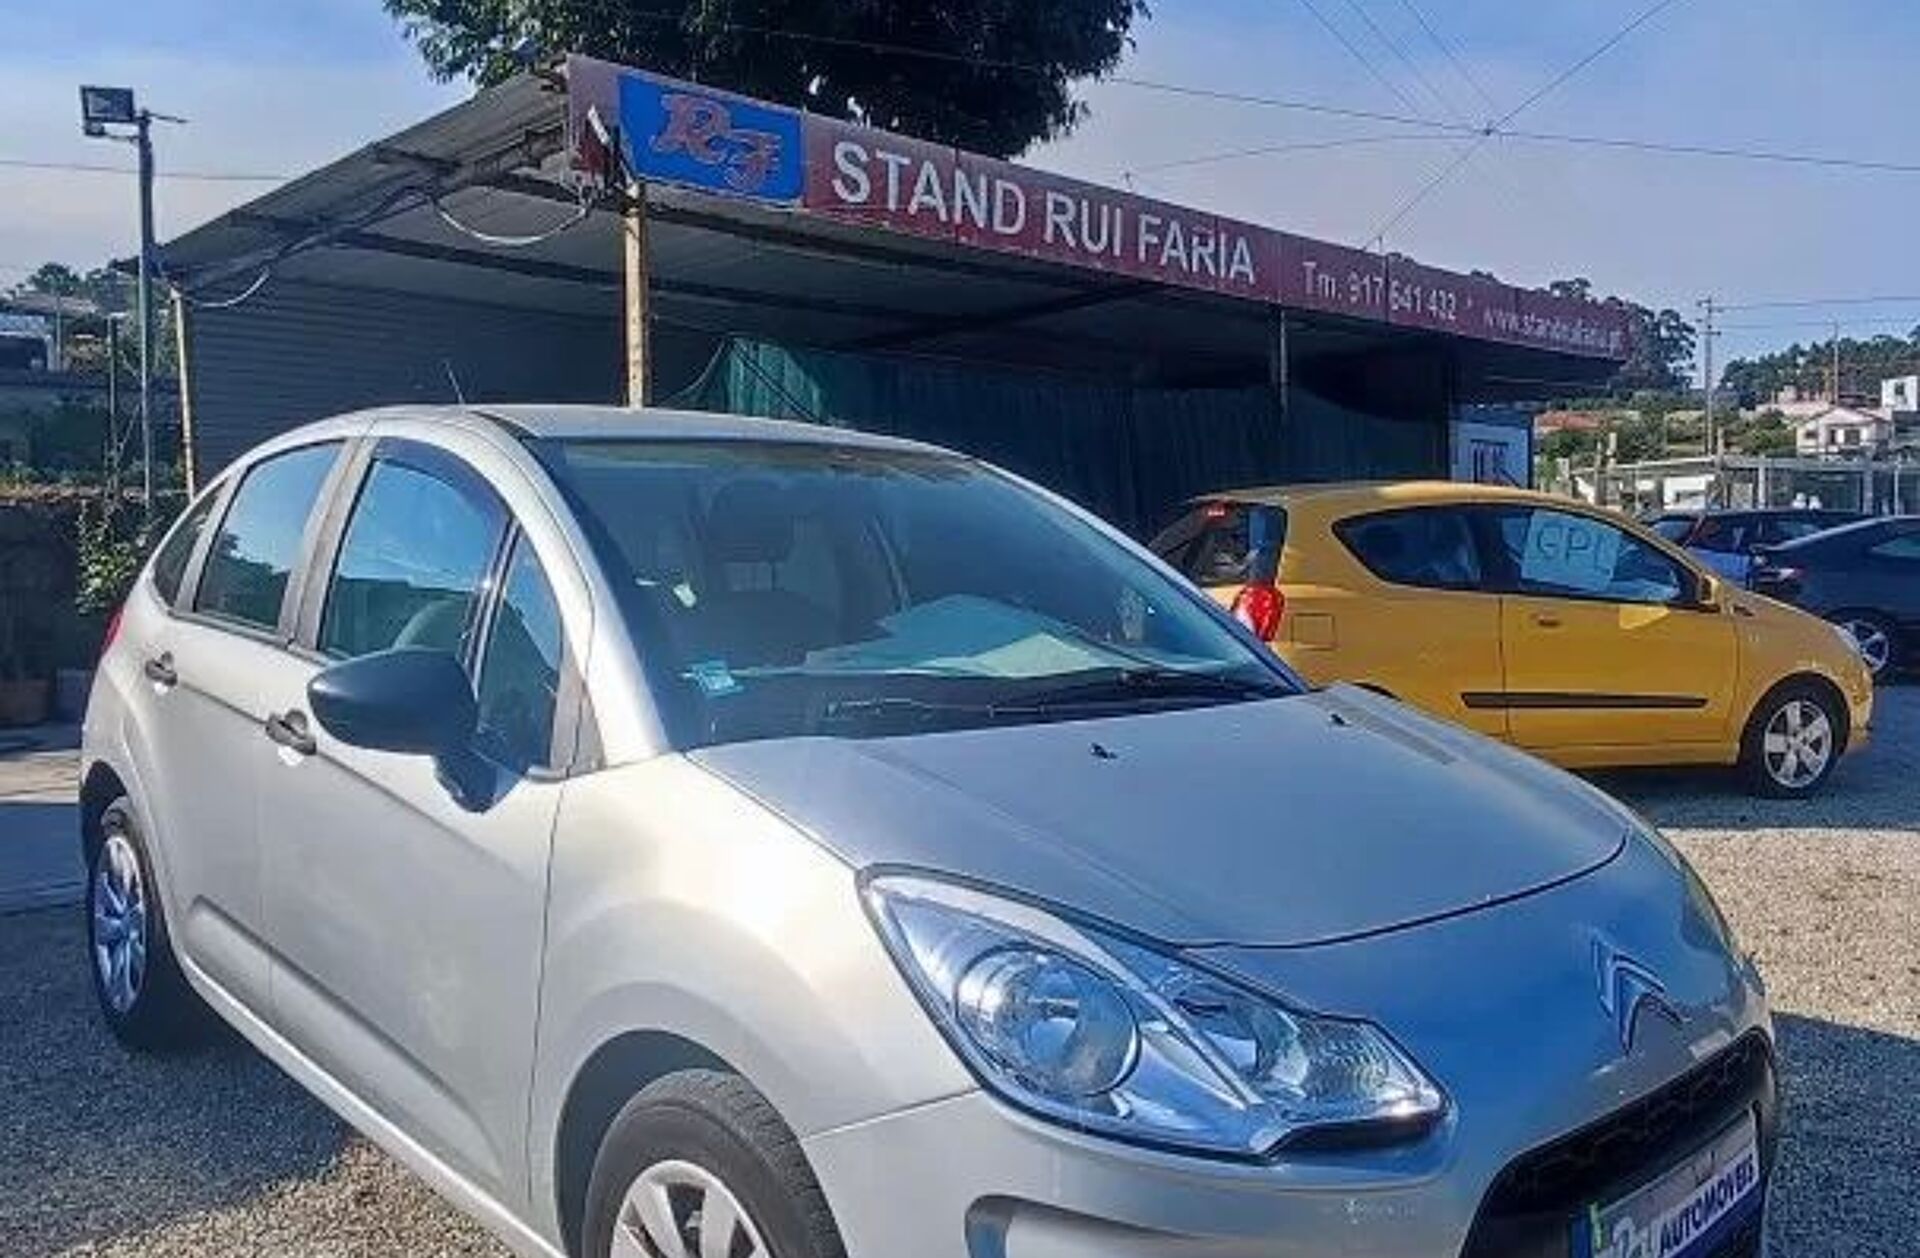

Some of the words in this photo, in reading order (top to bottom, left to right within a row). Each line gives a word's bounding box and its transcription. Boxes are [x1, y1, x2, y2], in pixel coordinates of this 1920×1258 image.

[831, 141, 1026, 235] STAND
[1045, 191, 1122, 257] RUI
[1138, 213, 1256, 285] FARIA
[1302, 261, 1342, 300] Tm.
